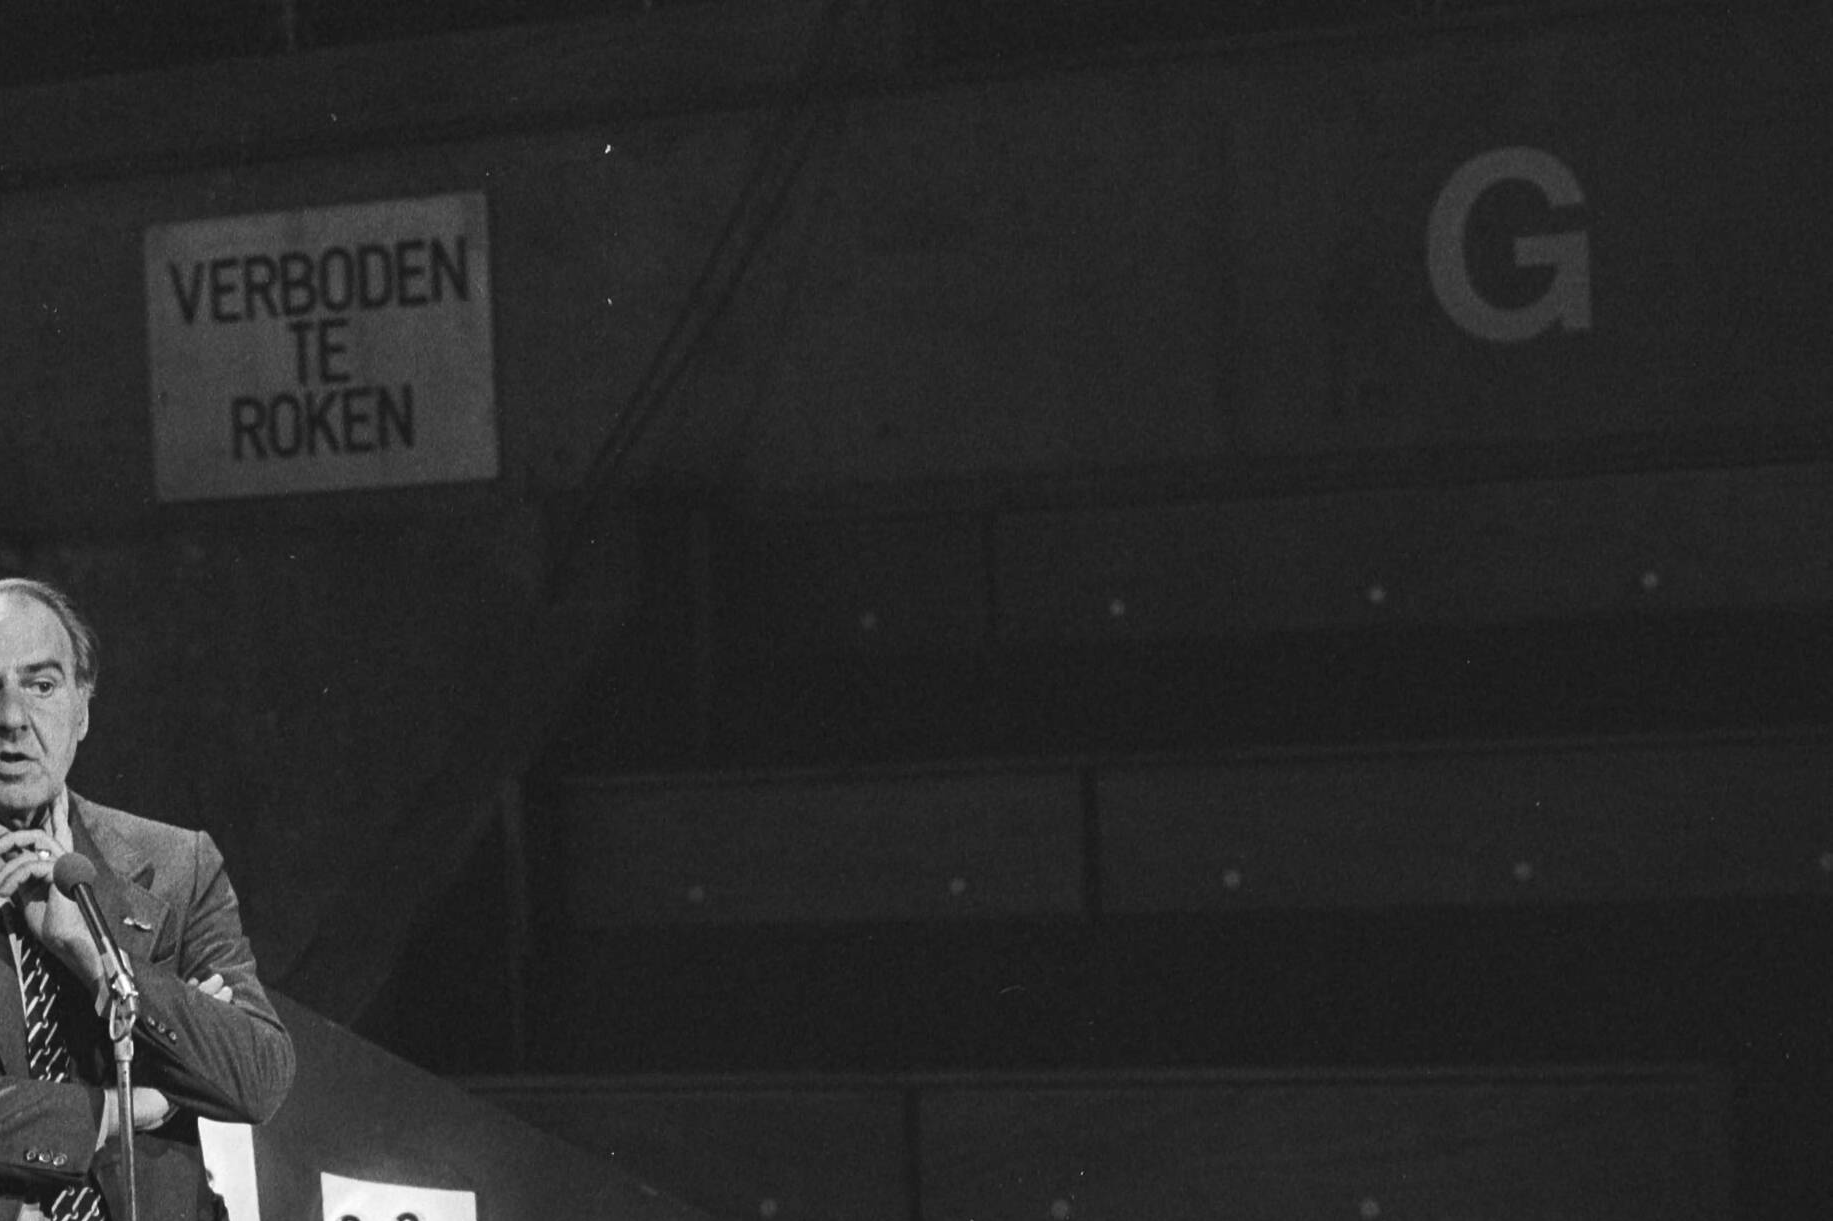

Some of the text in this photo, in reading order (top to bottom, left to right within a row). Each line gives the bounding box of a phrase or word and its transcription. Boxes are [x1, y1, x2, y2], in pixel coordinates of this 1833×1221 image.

[168, 235, 469, 326] VERBODEN
[1427, 146, 1592, 342] G
[287, 317, 350, 386] TE
[231, 384, 416, 461] ROKEN
